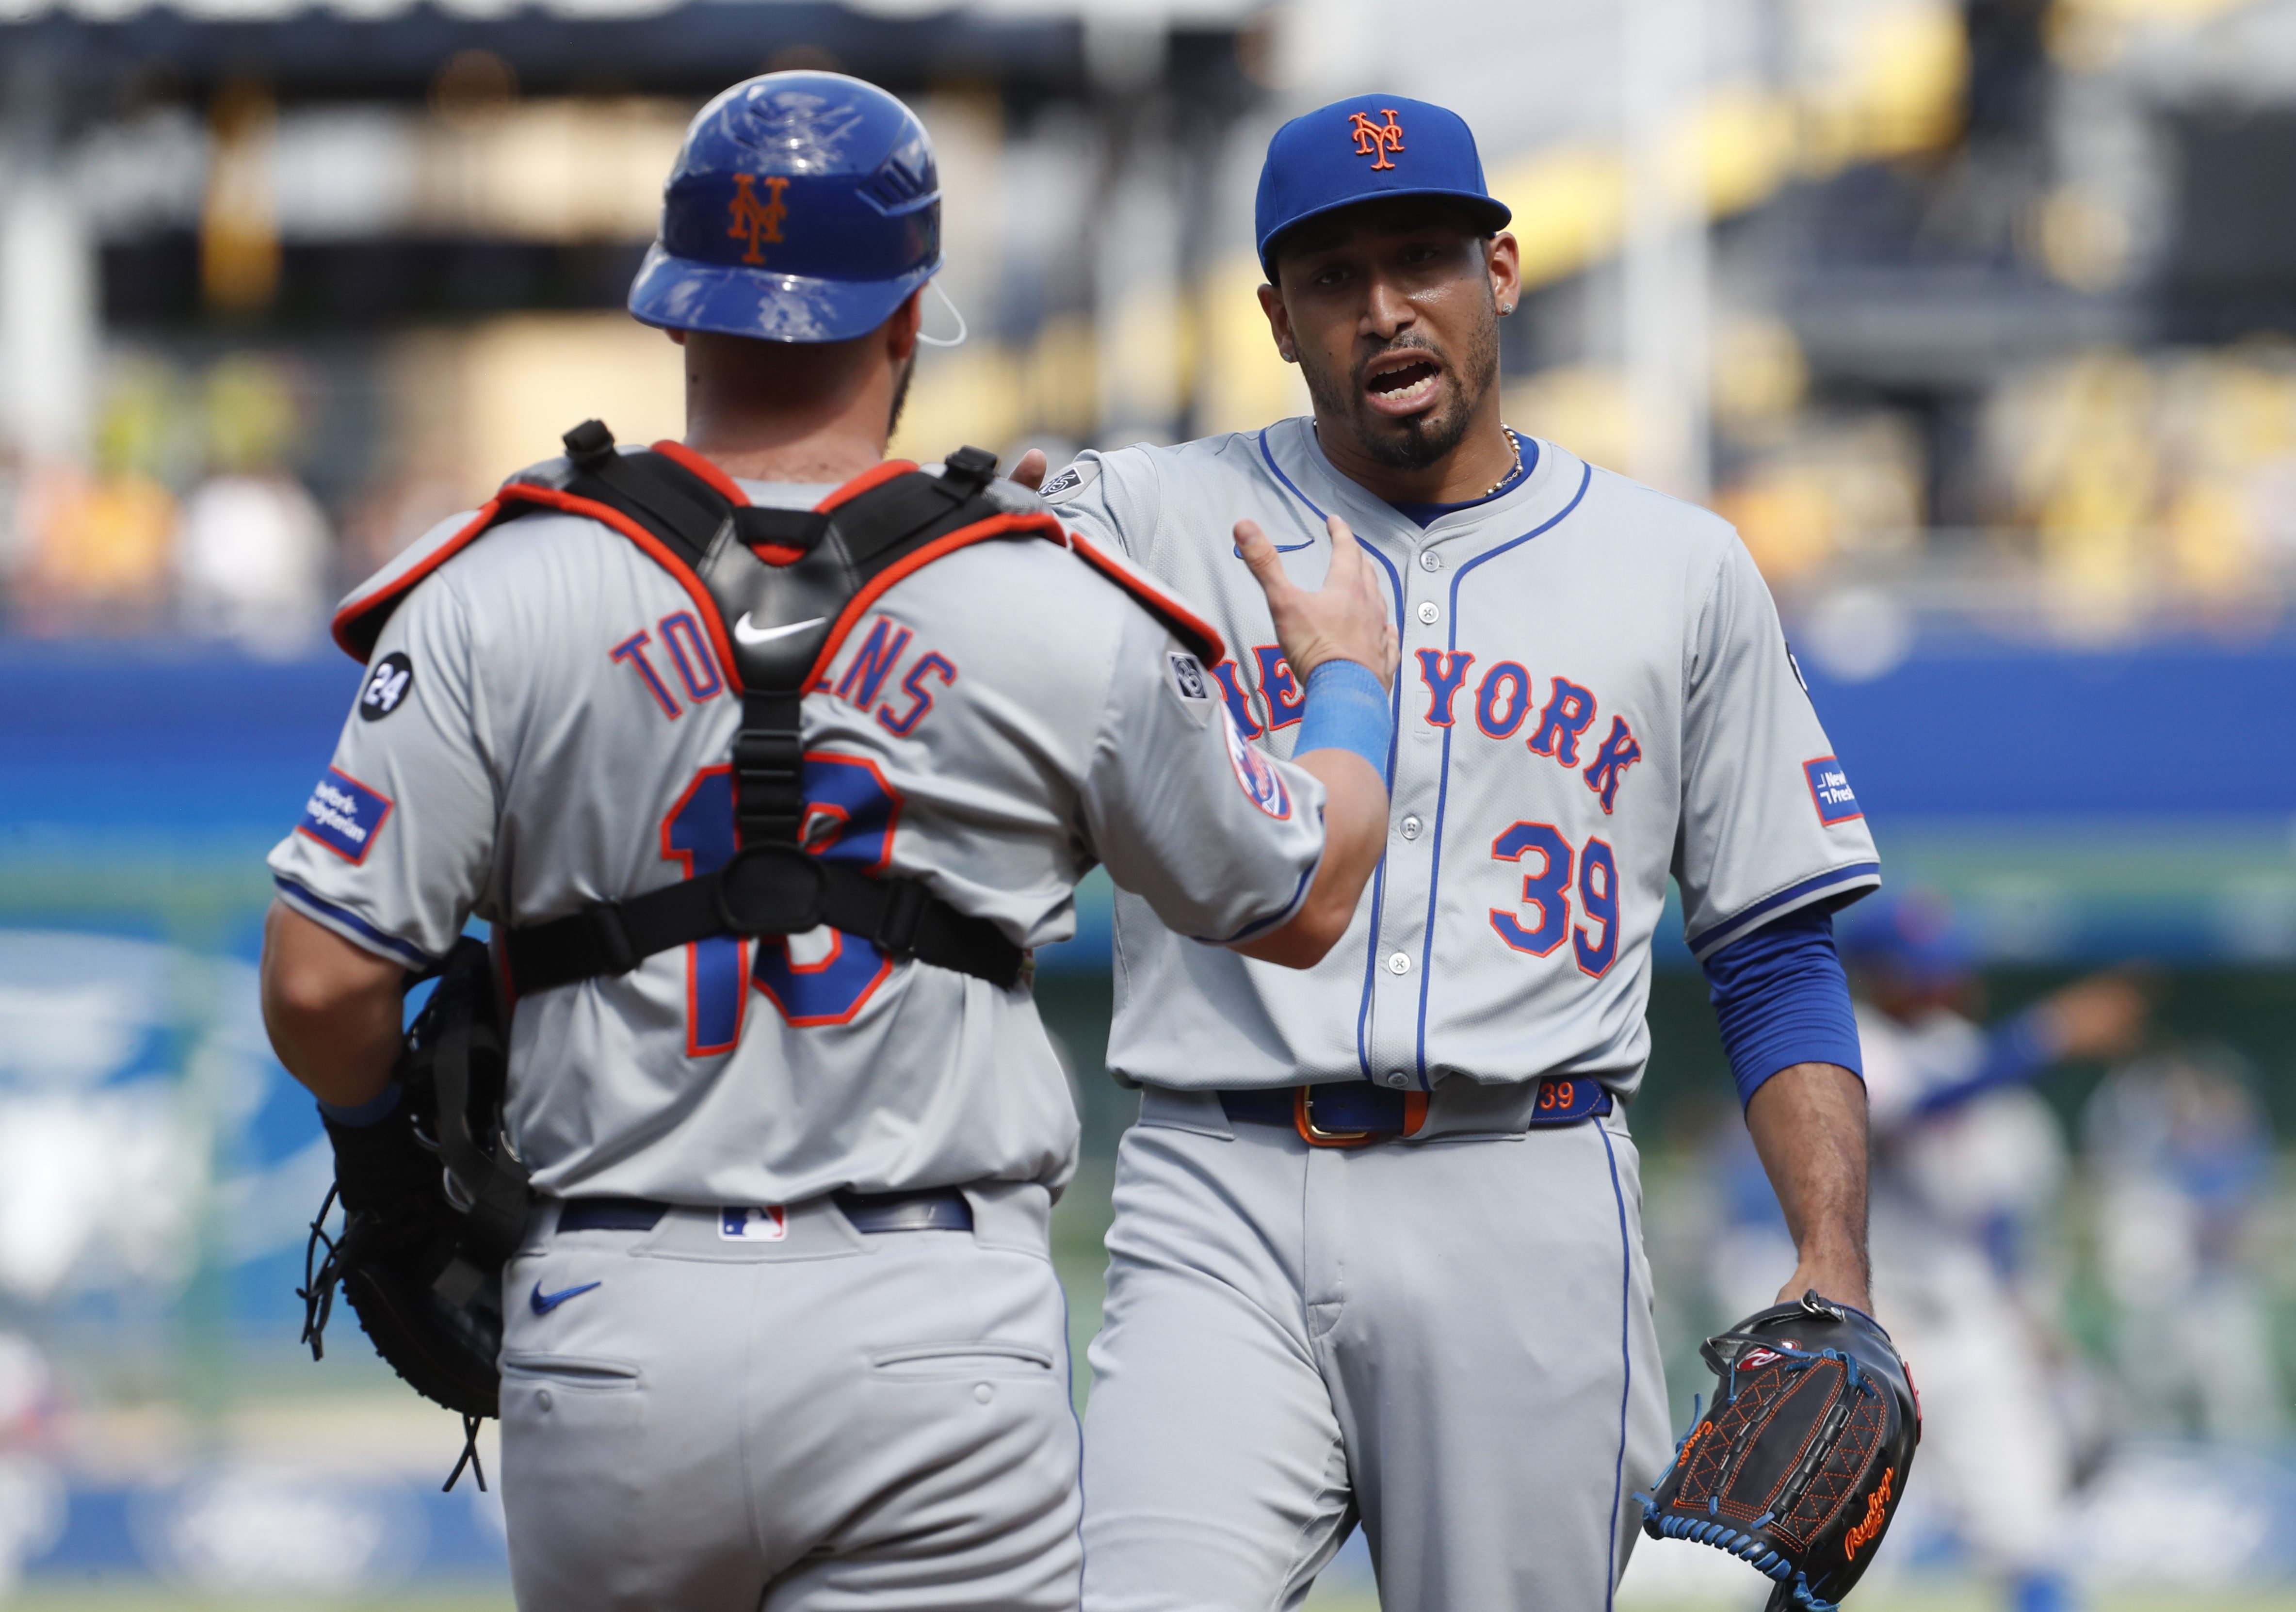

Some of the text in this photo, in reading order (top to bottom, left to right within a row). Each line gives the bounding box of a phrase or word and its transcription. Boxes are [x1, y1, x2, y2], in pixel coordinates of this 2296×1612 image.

[1348, 108, 1406, 171] NY
[728, 173, 790, 264] NY
[363, 662, 410, 711] 24
[609, 610, 957, 737] TONS
[1414, 647, 1641, 815] YORK
[1489, 820, 1619, 979] 39
[1539, 1081, 1574, 1110] 39
[1844, 1467, 1894, 1562] Rawlings
